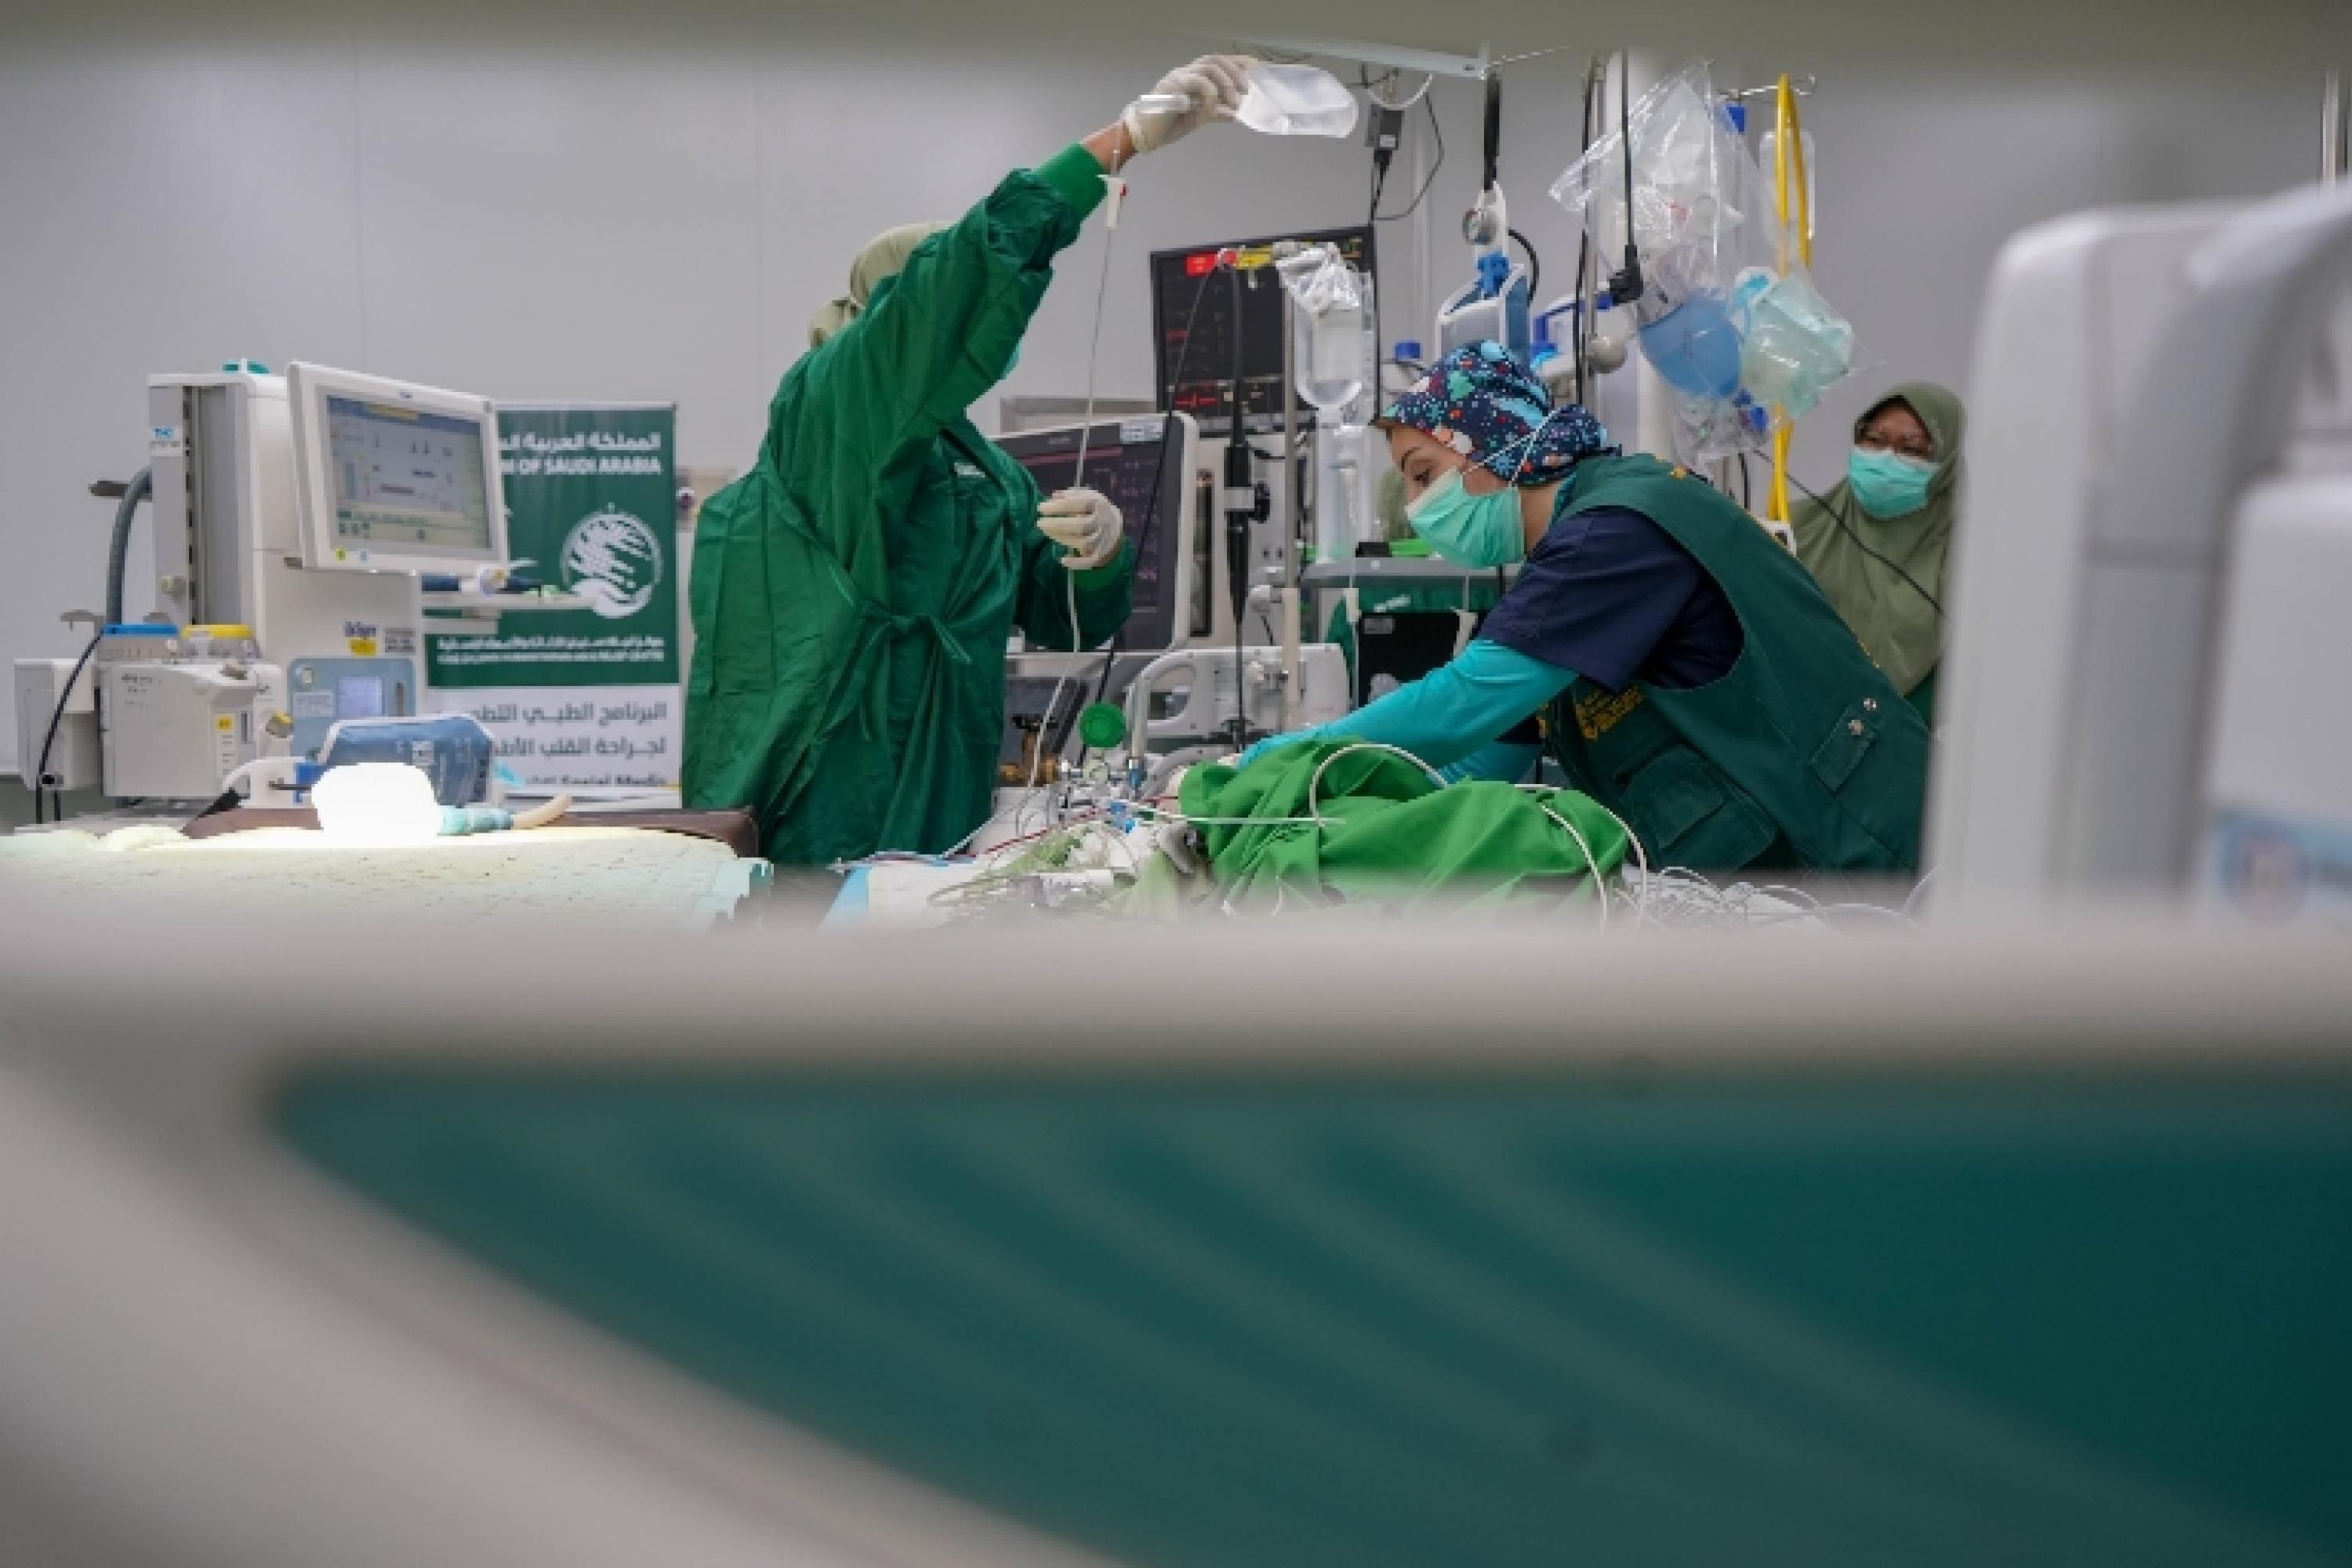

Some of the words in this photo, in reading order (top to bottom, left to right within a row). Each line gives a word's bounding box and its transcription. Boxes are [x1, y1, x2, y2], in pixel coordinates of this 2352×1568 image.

[522, 433, 585, 452] العربية
[588, 433, 661, 450] المملكة
[519, 457, 541, 474] OF
[545, 457, 597, 474] SAUDI
[599, 457, 661, 474] ARABIA
[522, 702, 593, 726] الطبي
[602, 702, 666, 726] البرنامج
[540, 737, 591, 757] القلب
[596, 737, 666, 759] لجراحة
